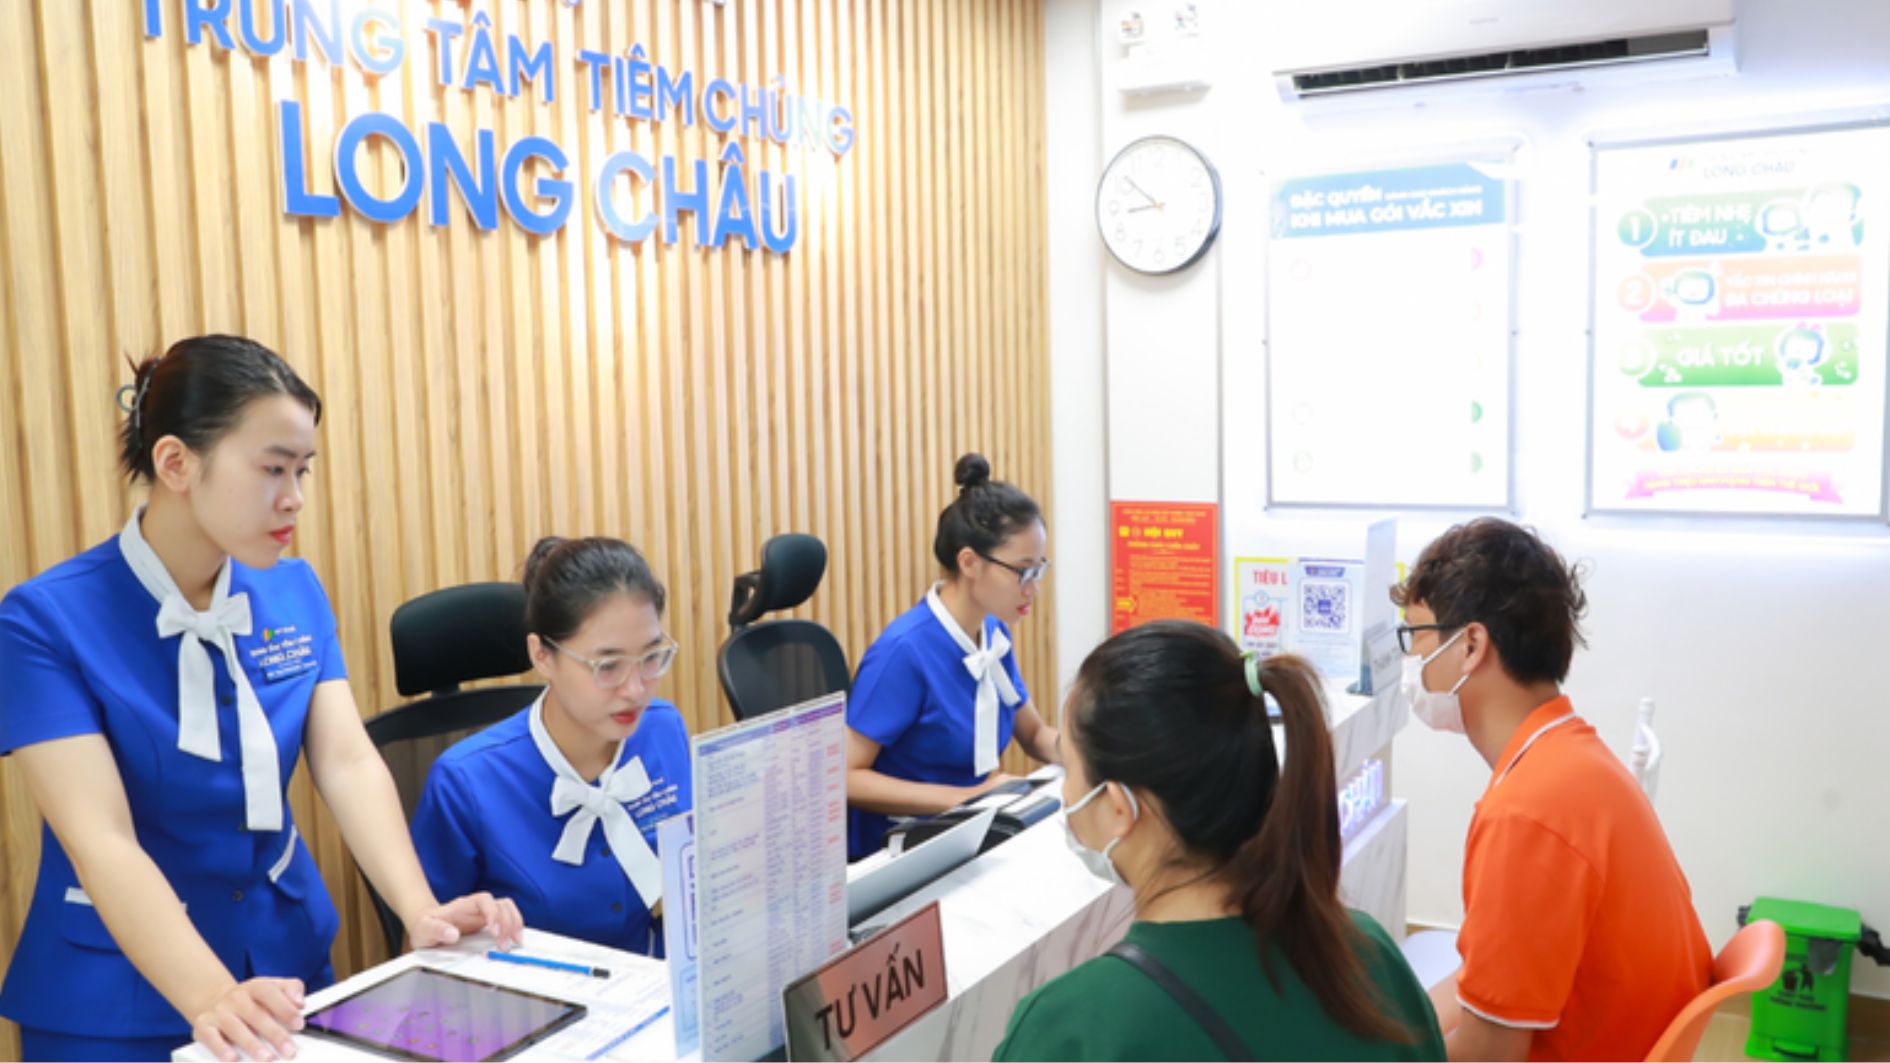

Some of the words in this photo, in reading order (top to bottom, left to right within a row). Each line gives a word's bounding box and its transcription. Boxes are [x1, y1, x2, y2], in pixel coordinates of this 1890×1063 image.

[428, 11, 555, 102] TÂM
[579, 44, 693, 126] TIÊM
[281, 100, 574, 236] LONG
[597, 142, 798, 254] CHÂU
[1290, 211, 1321, 229] KHI
[1325, 208, 1368, 227] MUA
[1370, 200, 1404, 223] GÓI
[1449, 199, 1483, 217] XIN
[1677, 341, 1715, 367] GIÁ
[1719, 340, 1764, 367] TỐT
[815, 983, 857, 1050] TƯ
[861, 942, 924, 1020] VẤN
